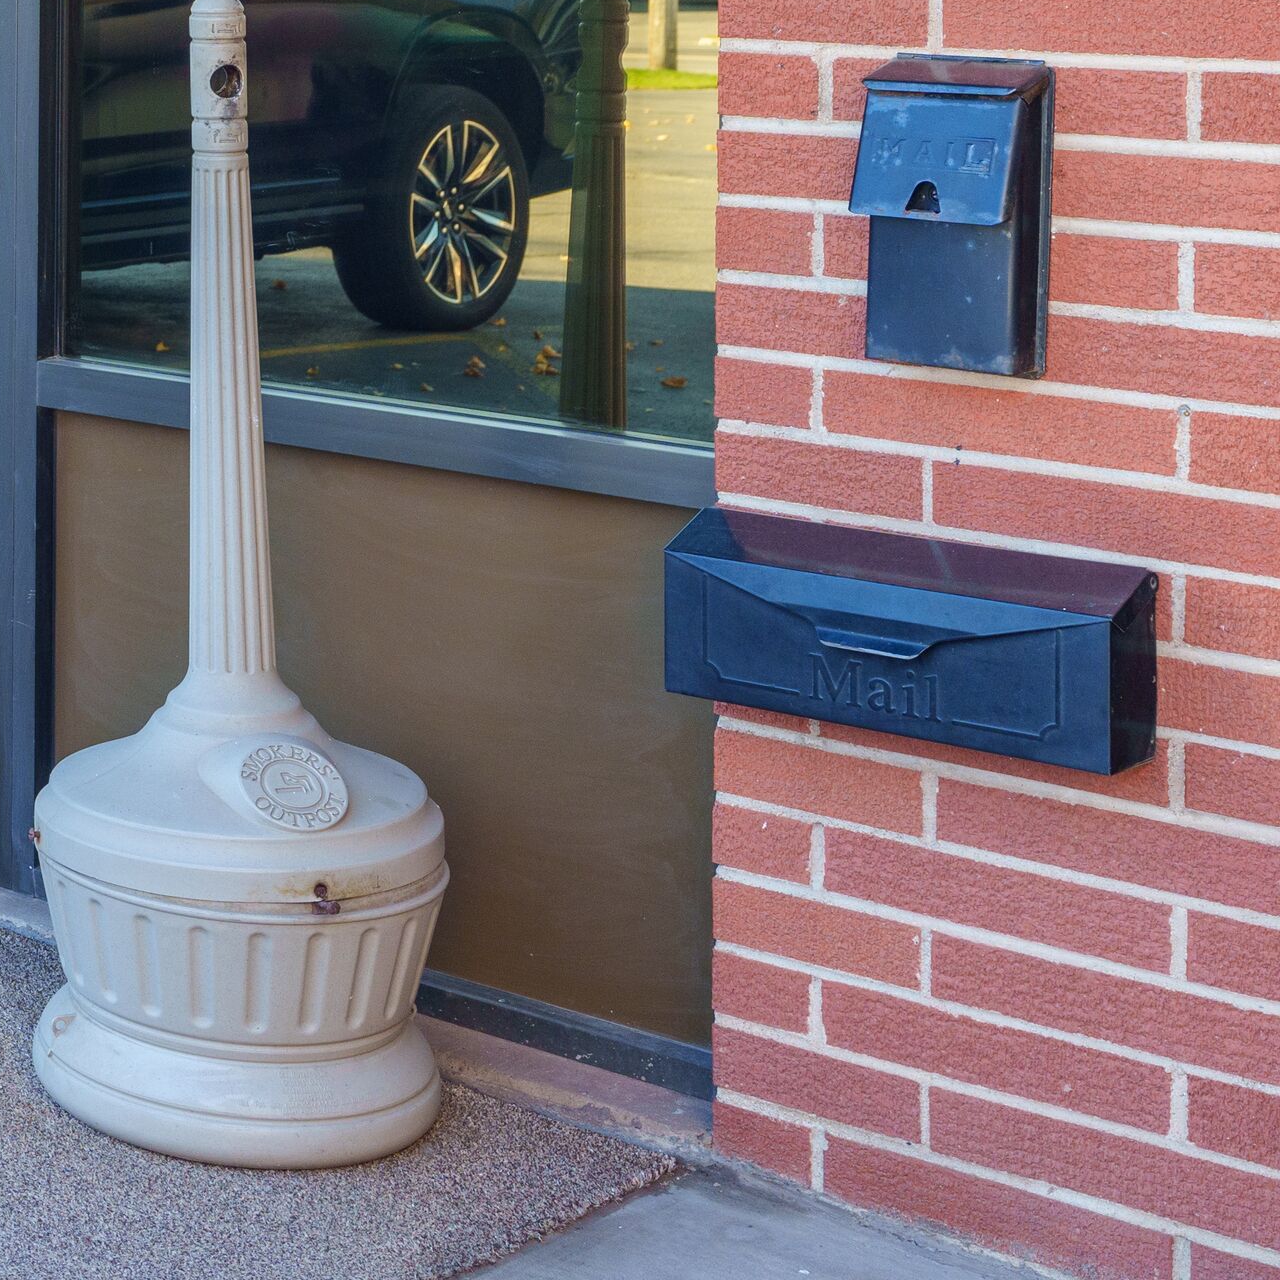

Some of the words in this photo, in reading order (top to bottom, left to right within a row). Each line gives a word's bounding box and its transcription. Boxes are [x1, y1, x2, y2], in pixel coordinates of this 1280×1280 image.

[874, 137, 992, 173] MAIL
[808, 651, 942, 723] Mail
[254, 791, 346, 828] OUTPOST
